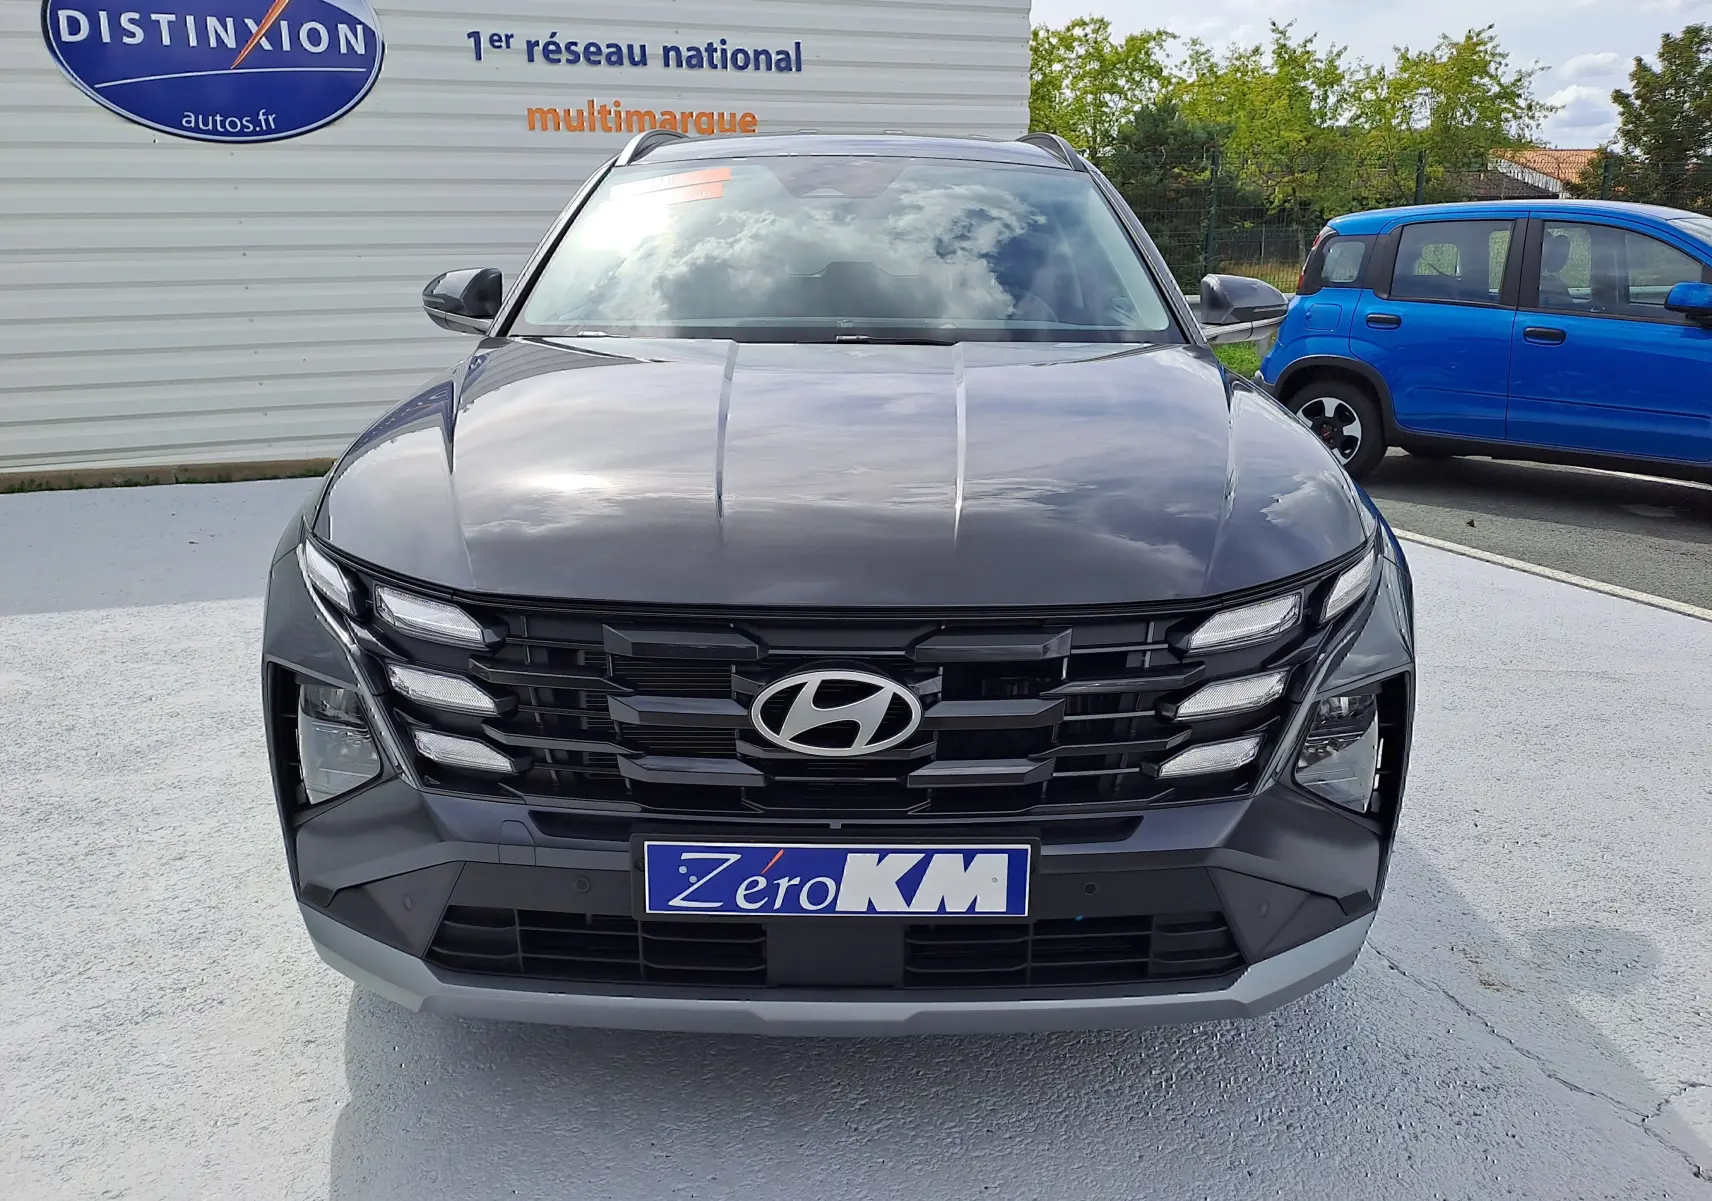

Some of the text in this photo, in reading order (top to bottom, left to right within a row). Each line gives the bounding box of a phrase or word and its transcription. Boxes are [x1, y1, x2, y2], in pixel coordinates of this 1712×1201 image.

[57, 8, 366, 55] DISTINXION
[466, 30, 802, 72] 1er réseau national
[180, 109, 277, 132] autos.fr
